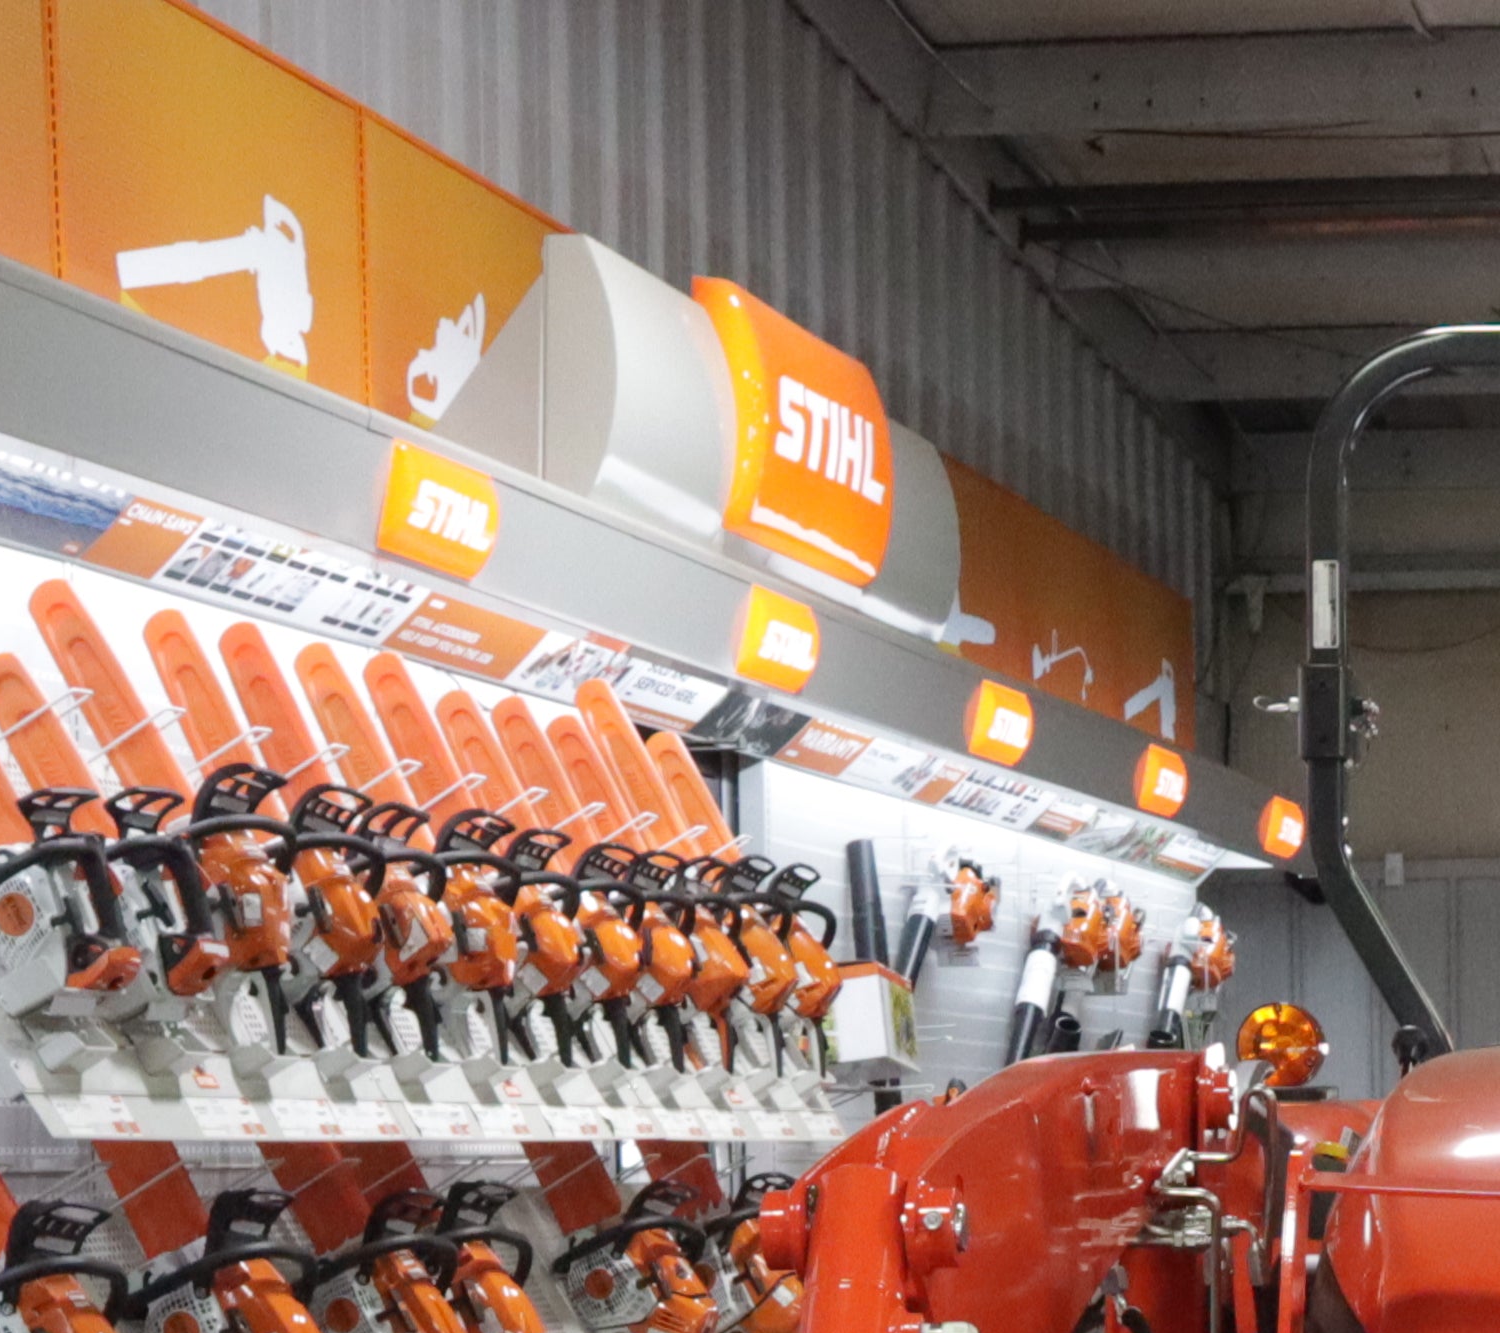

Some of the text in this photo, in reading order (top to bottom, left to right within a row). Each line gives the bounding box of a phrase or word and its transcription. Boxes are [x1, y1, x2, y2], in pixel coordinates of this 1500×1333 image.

[774, 374, 886, 505] STIHL
[126, 502, 198, 535] CHAIN SAWS
[406, 478, 495, 552] STIHL
[758, 619, 815, 672] STIHL
[987, 706, 1029, 749] STIHL
[1154, 767, 1185, 803] STIHL
[1277, 815, 1304, 848] STIHL
